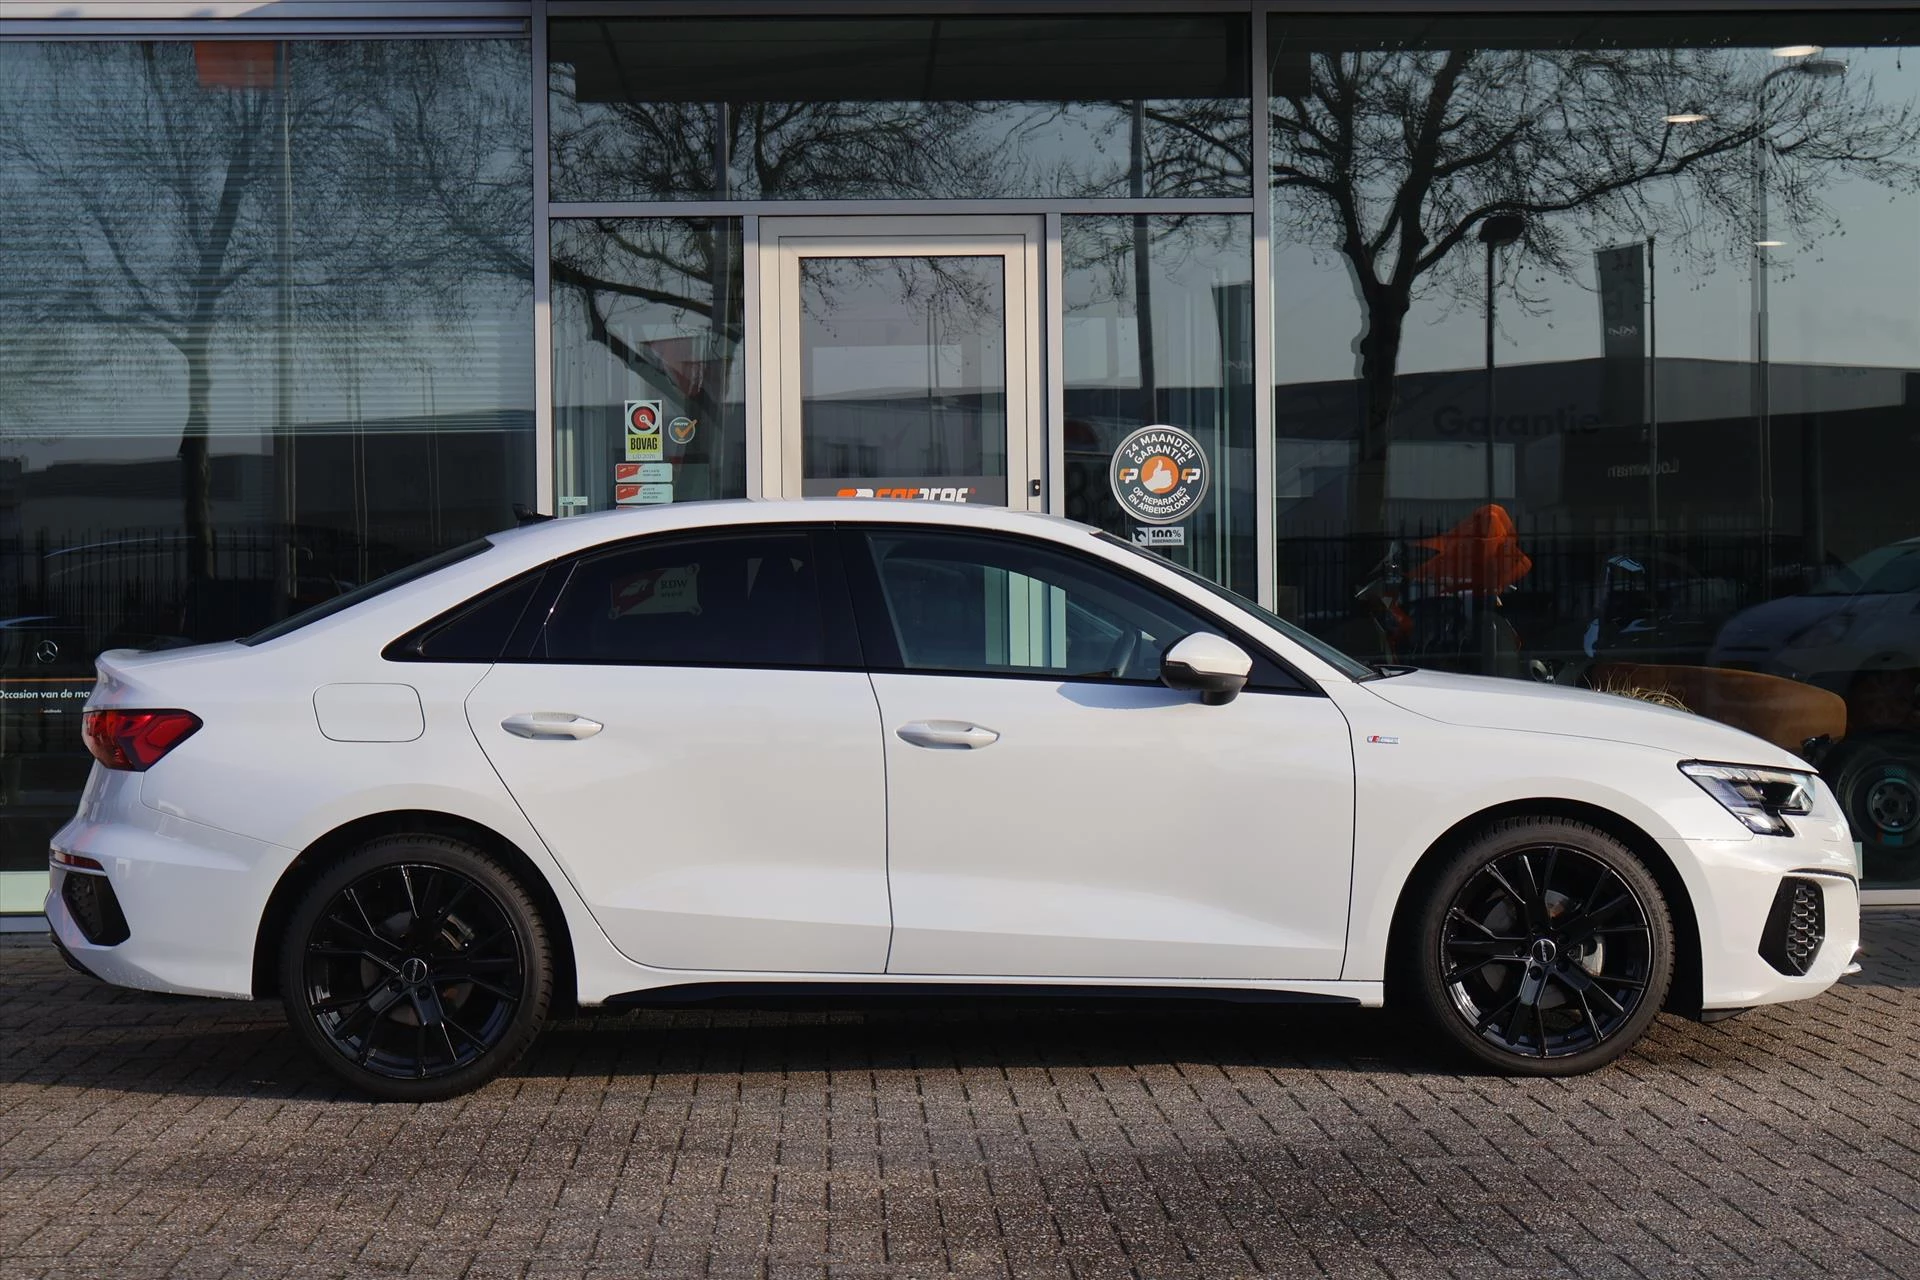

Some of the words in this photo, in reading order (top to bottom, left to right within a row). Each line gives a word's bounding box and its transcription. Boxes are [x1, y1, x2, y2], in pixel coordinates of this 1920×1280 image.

[1433, 403, 1602, 436] Garantie
[630, 437, 658, 451] BOVAG
[1125, 443, 1140, 458] 24
[1140, 433, 1196, 459] MAANDEN
[1134, 444, 1187, 465] GARANTIE
[1128, 494, 1139, 506] EN
[1138, 495, 1191, 515] ARBEIDSLOON
[1133, 486, 1144, 499] OP
[1144, 486, 1187, 506] REPARATIES
[1151, 529, 1182, 538] 100%
[0, 689, 38, 699] Occasion
[40, 691, 58, 699] van
[61, 689, 73, 699] de
[75, 691, 91, 699] ma
